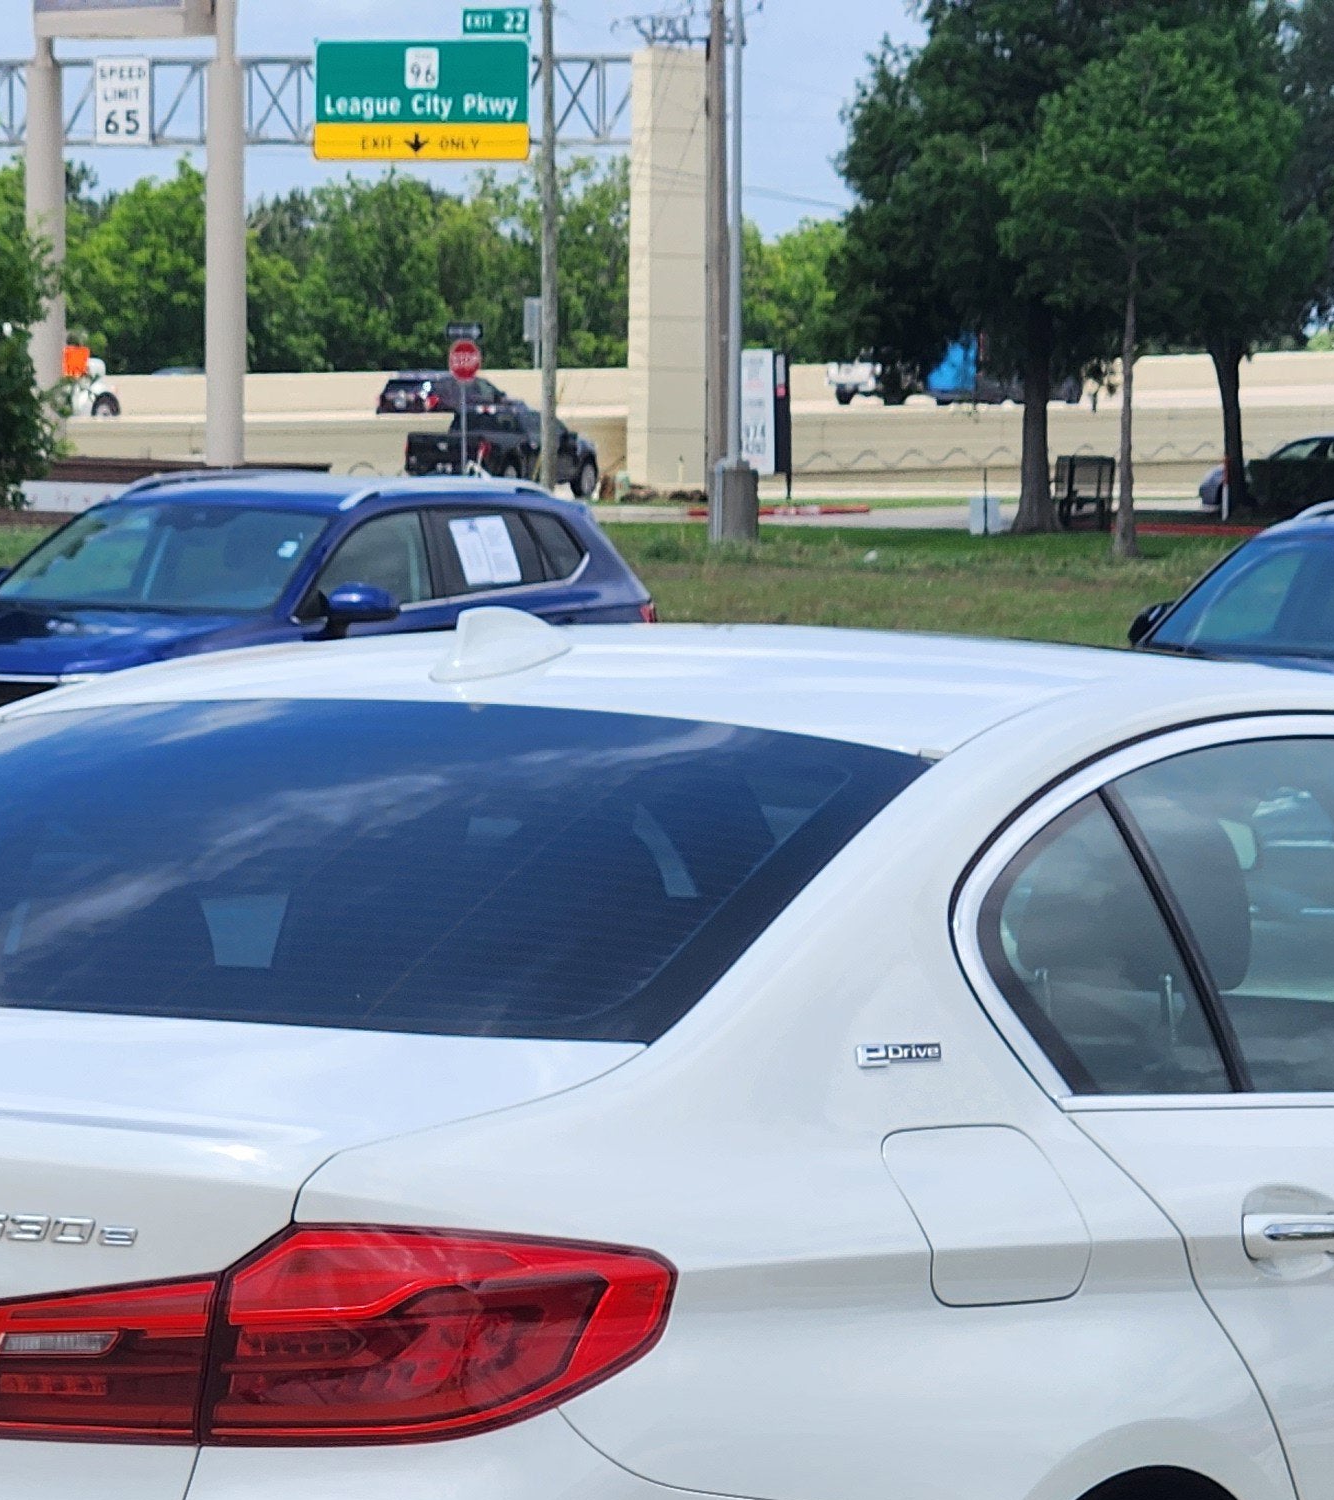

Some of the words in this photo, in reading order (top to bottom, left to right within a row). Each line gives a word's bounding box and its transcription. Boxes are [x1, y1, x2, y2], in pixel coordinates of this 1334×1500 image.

[465, 13, 493, 29] EXIT
[503, 10, 526, 31] 22
[99, 66, 146, 79] SPEED
[410, 61, 436, 83] 96
[103, 87, 139, 101] LIMIT
[324, 94, 401, 121] League
[411, 92, 453, 121] City
[462, 93, 518, 121] Pkwy
[105, 109, 140, 135] 65
[361, 137, 393, 150] EXIT
[439, 137, 480, 150] ONLY
